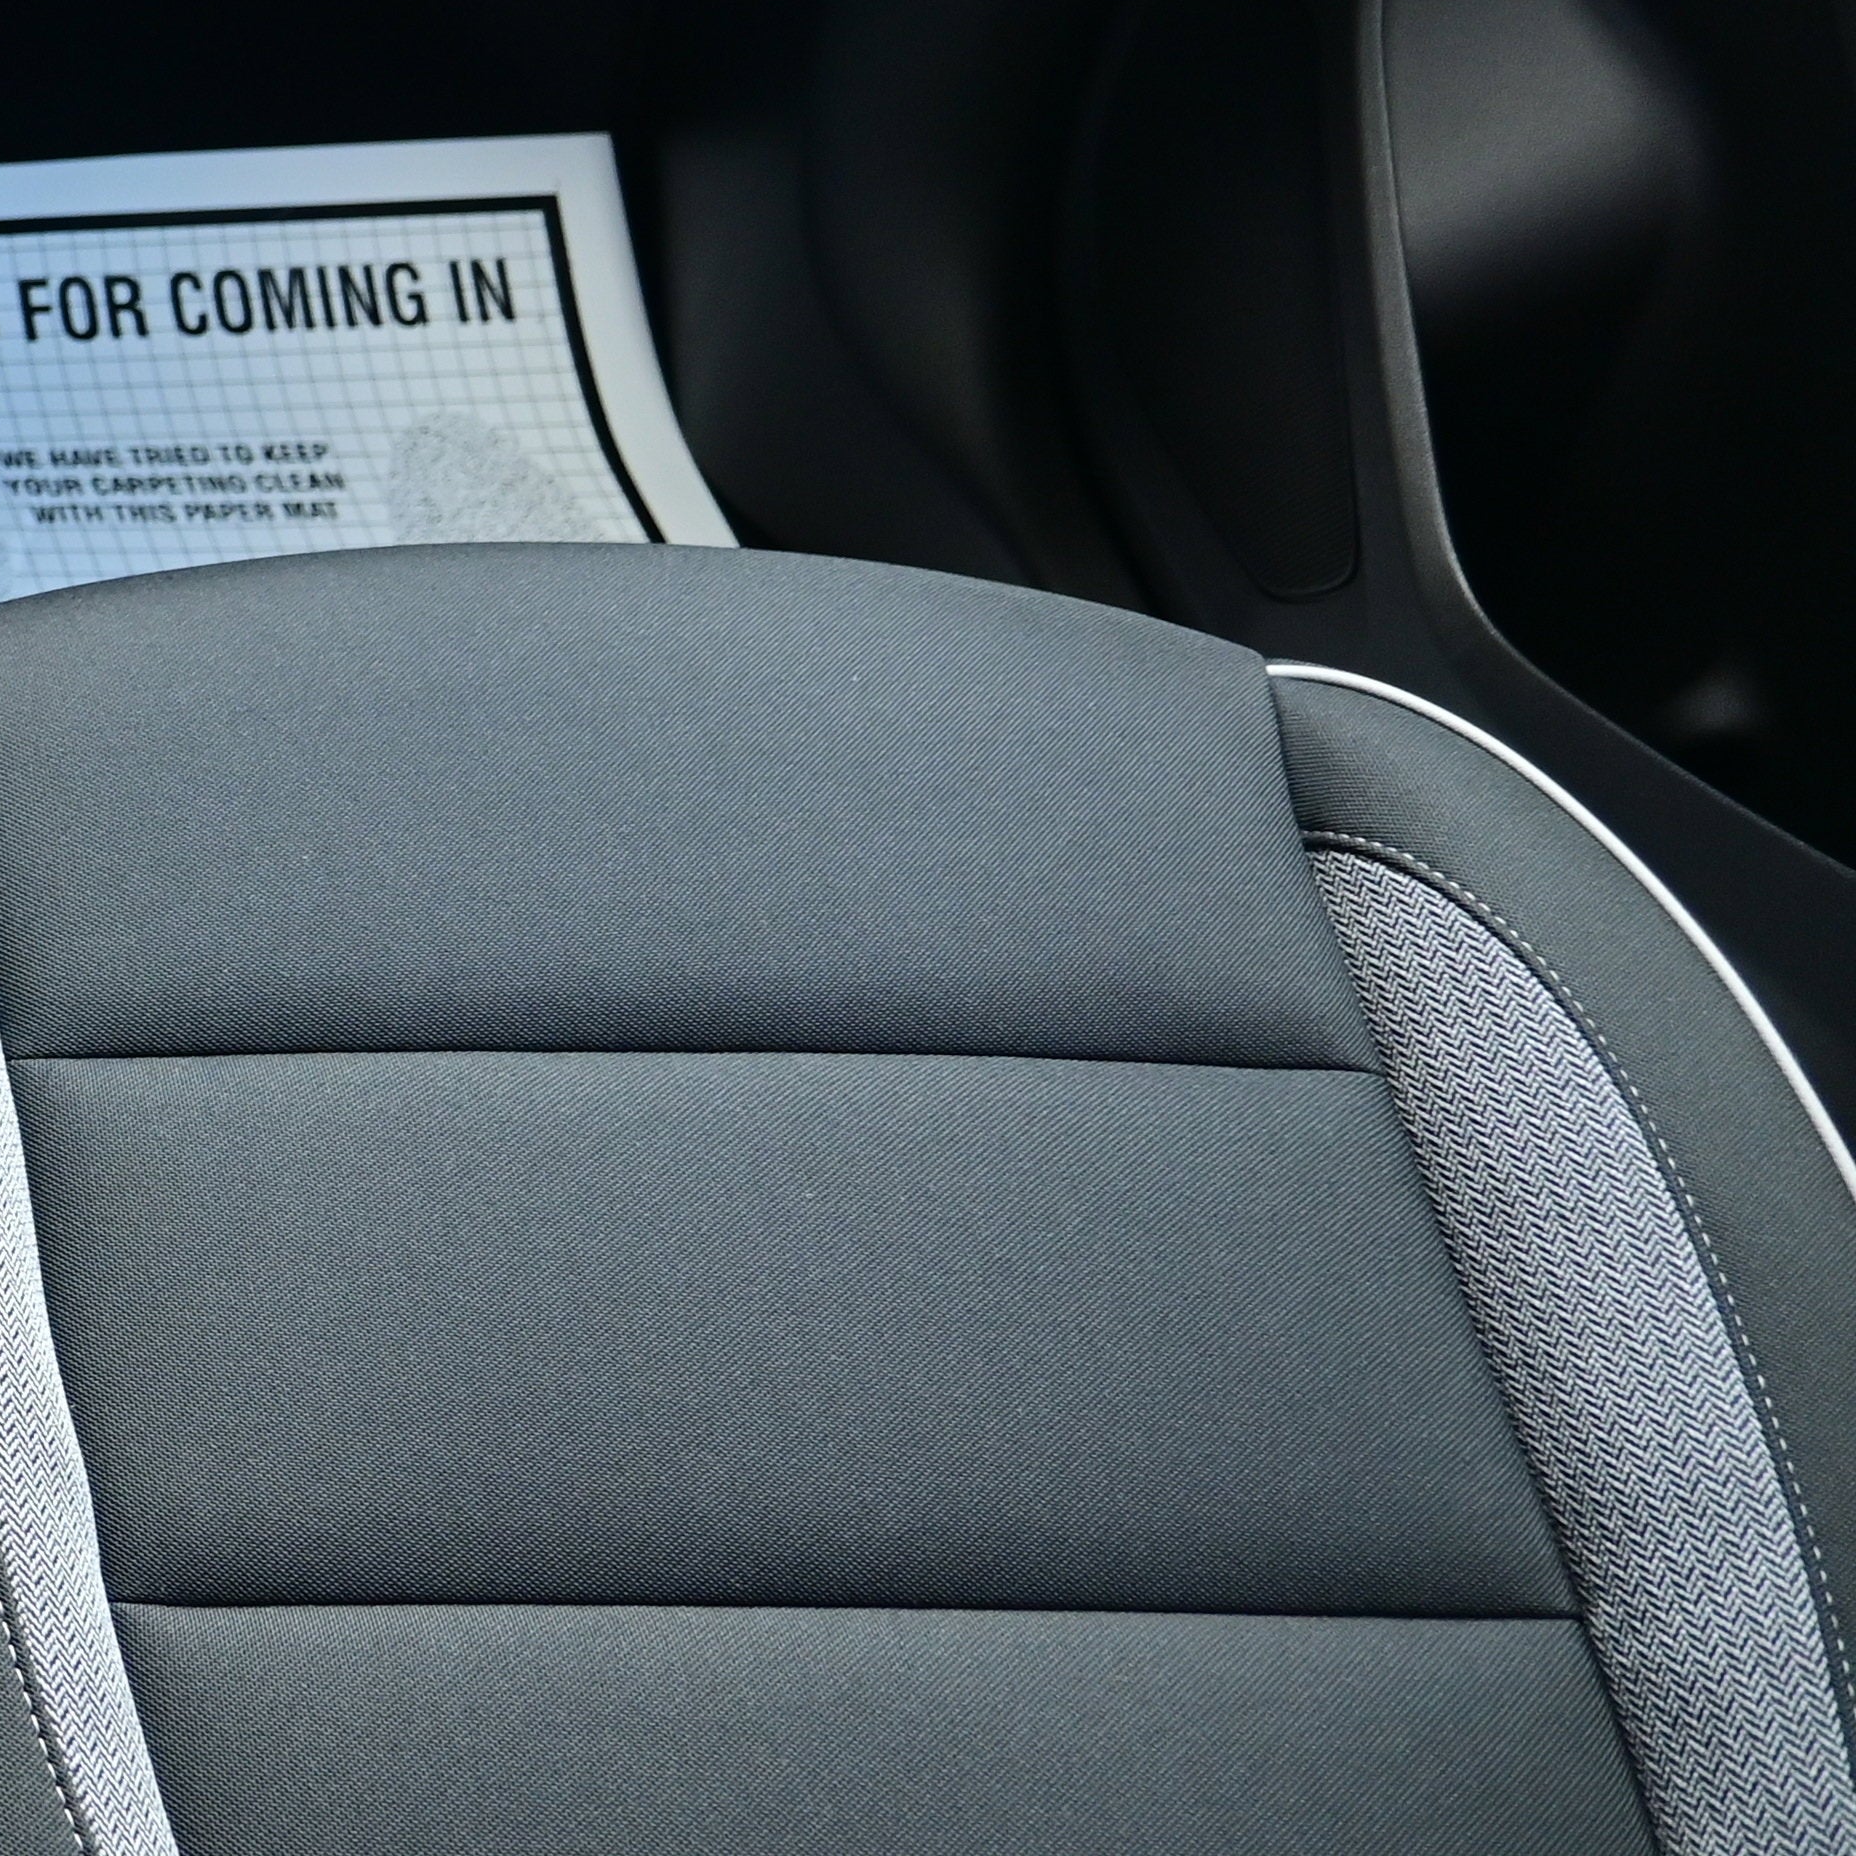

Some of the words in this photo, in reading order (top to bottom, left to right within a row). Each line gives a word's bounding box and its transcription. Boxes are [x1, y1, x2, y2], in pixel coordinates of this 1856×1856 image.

[20, 276, 149, 341] FOR
[171, 261, 430, 337] COMING
[451, 258, 517, 322] IN
[0, 449, 40, 469] WE
[49, 448, 120, 468] HAVE
[130, 445, 210, 466] TRIED
[217, 444, 255, 465] TO
[262, 443, 328, 464] KEEP
[3, 478, 83, 496] YOUR
[91, 474, 248, 495] CARPETING
[254, 472, 344, 493] CLEAN
[30, 503, 105, 524] WITH
[114, 504, 177, 522] THIS
[184, 502, 275, 523] PAPER
[282, 500, 337, 520] MAT
